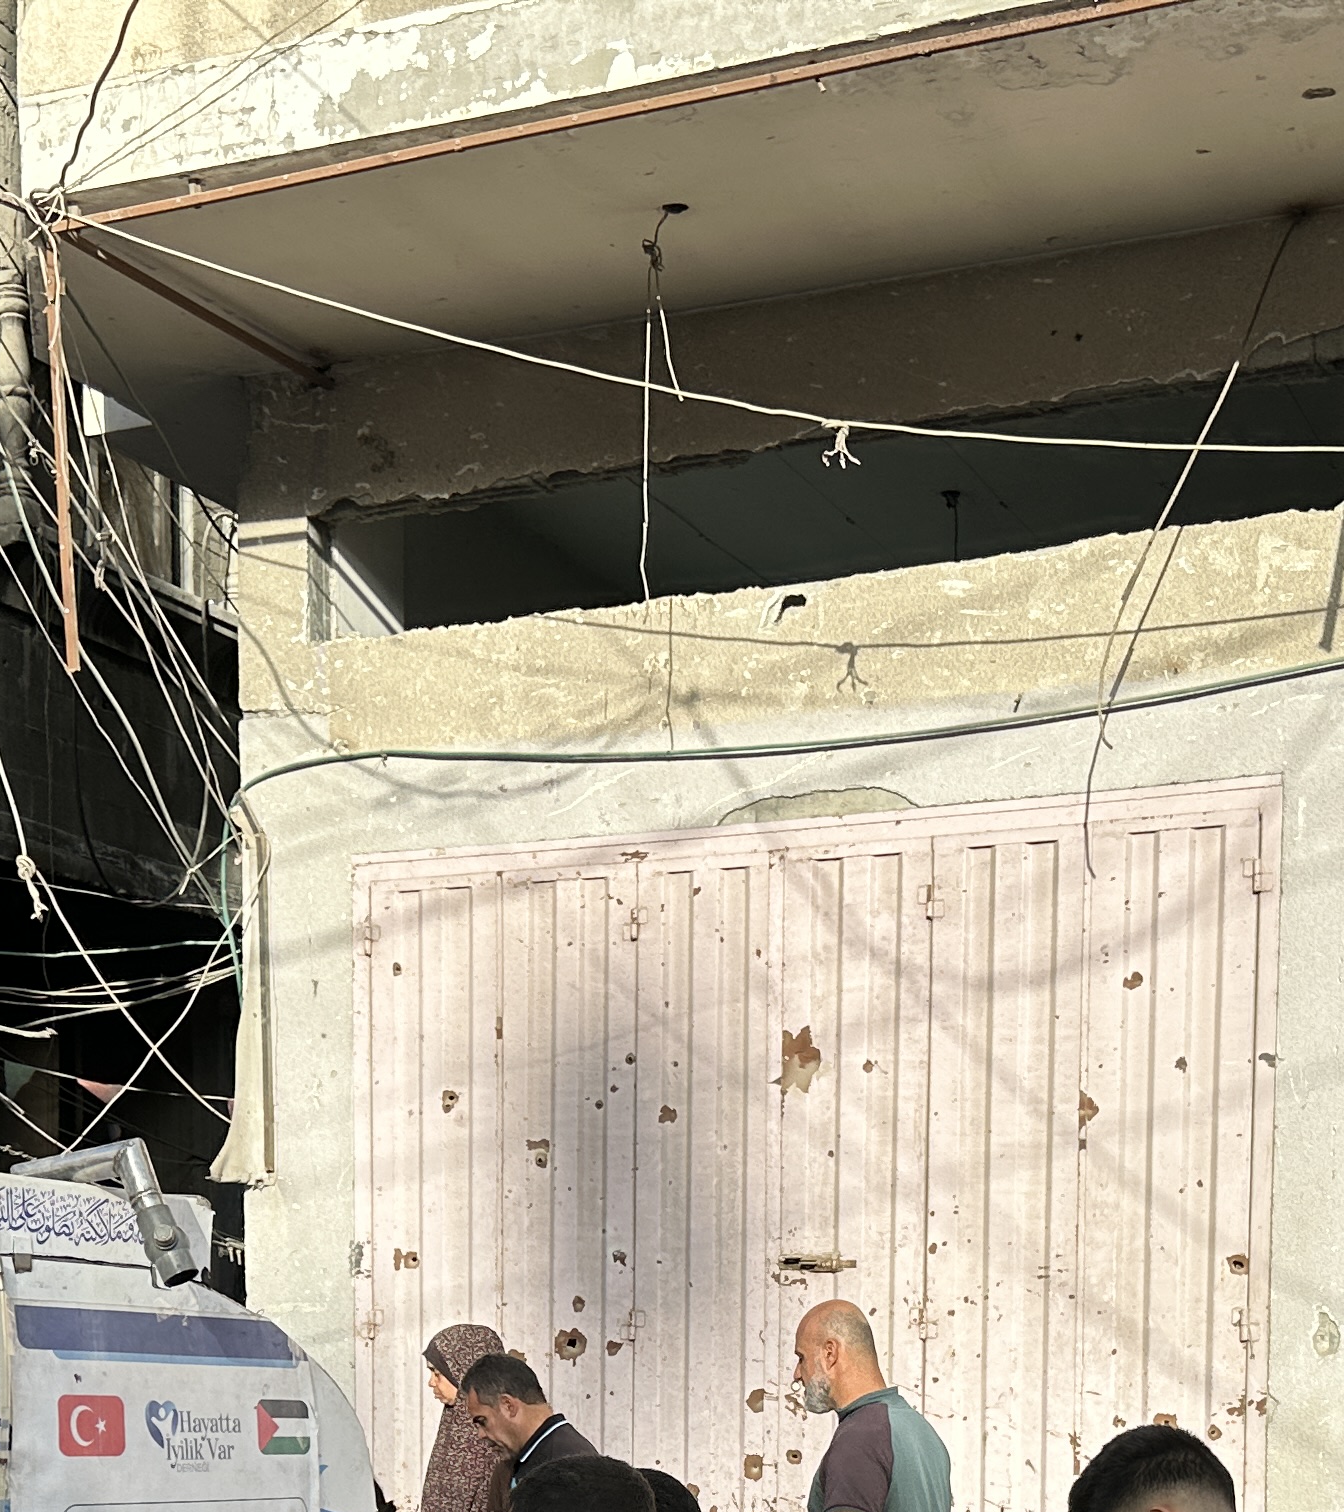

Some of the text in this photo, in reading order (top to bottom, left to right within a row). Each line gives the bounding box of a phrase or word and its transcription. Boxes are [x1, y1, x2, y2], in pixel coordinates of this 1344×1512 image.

[179, 1410, 241, 1441] Hayatta
[166, 1433, 235, 1469] İyilik Var
